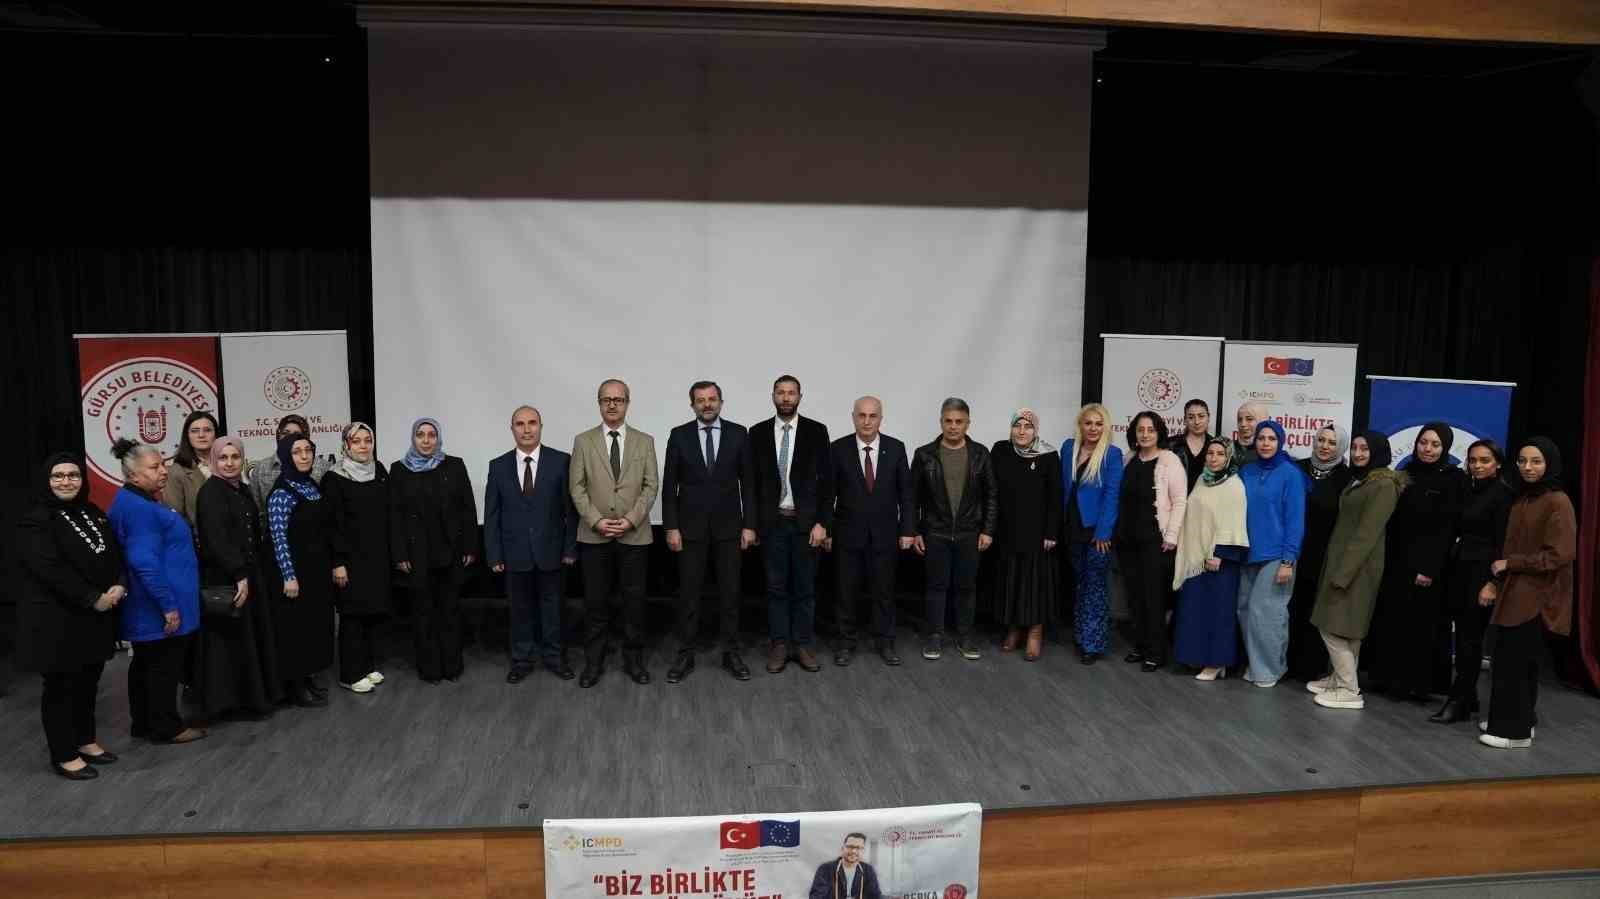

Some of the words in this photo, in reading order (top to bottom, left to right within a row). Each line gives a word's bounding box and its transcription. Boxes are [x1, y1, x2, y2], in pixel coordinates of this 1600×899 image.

[88, 376, 127, 417] GÜRSU
[238, 428, 276, 438] TEKNOL
[311, 424, 343, 433] ANLIĞI
[650, 866, 755, 895] BİRLİKTE
